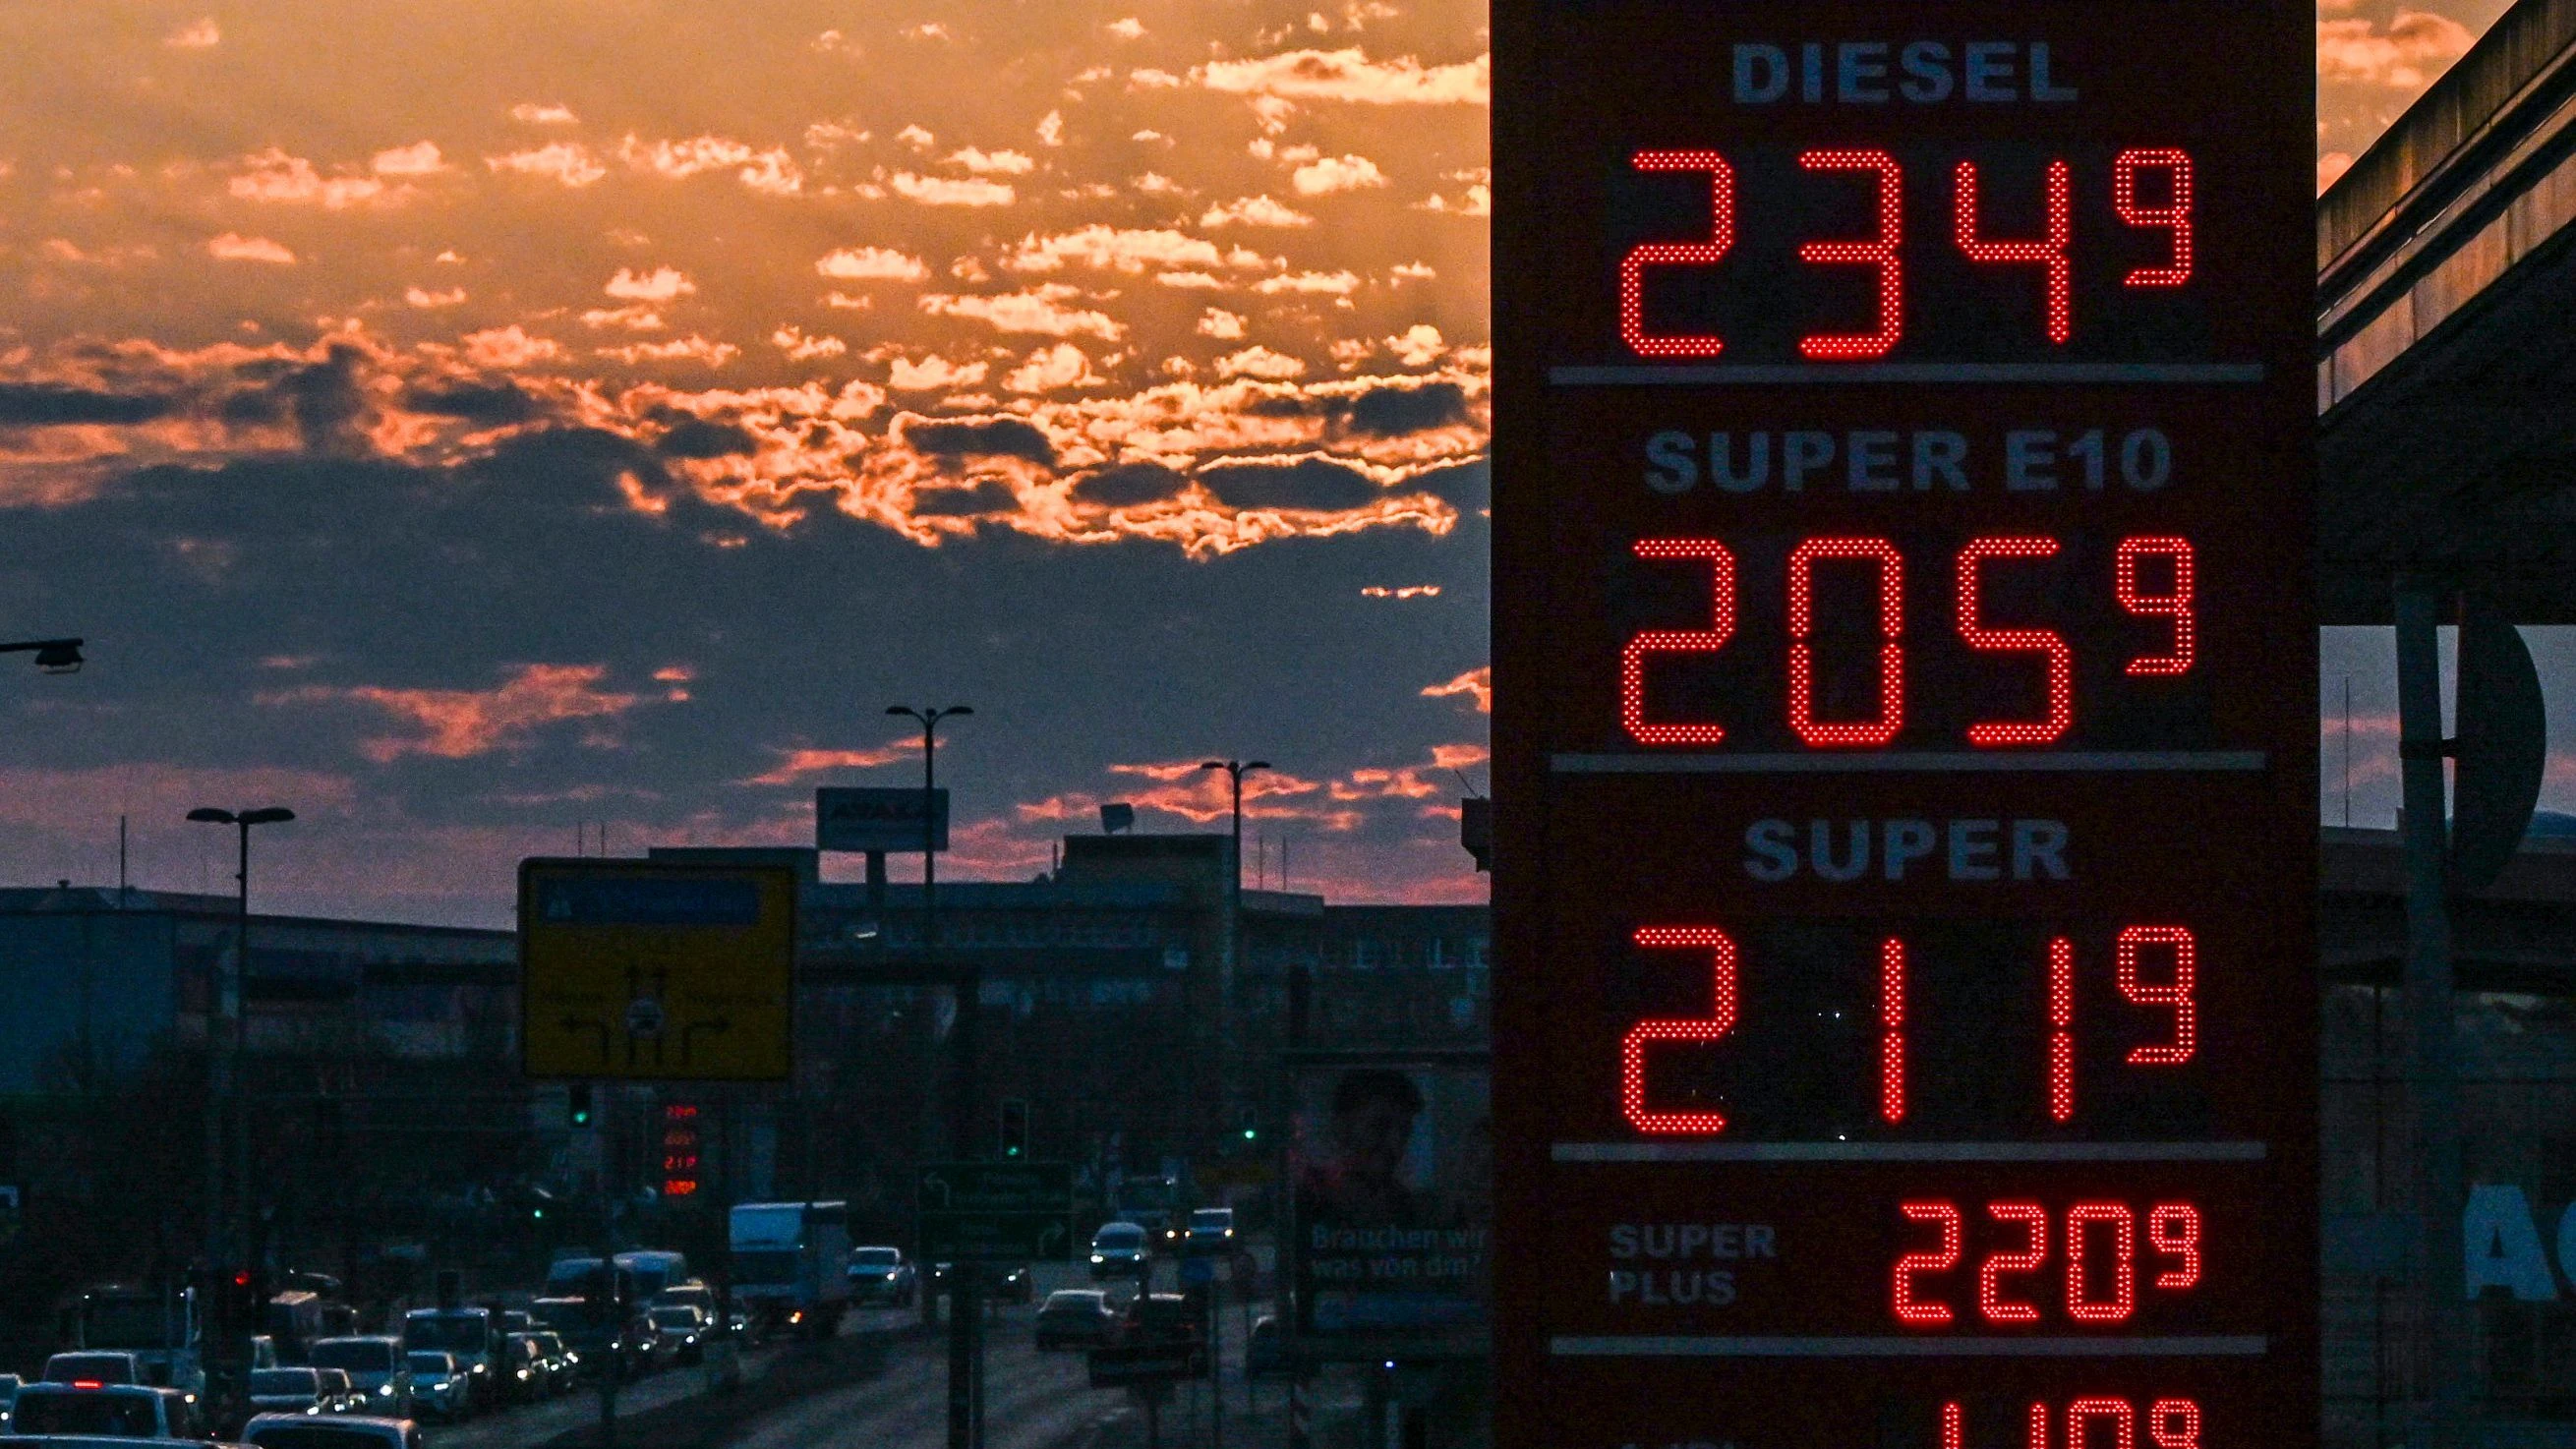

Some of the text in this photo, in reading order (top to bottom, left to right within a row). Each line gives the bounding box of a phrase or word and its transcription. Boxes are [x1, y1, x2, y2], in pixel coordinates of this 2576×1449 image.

[1732, 41, 2078, 103] DIESEL
[1644, 429, 2172, 493] SUPER E10
[1743, 819, 2069, 882] SUPER
[1311, 1222, 1439, 1251] Brauchen
[1609, 1223, 1778, 1259] SUPER
[1310, 1255, 1364, 1279] was
[1369, 1254, 1419, 1279] von
[1608, 1268, 1737, 1305] PLUS
